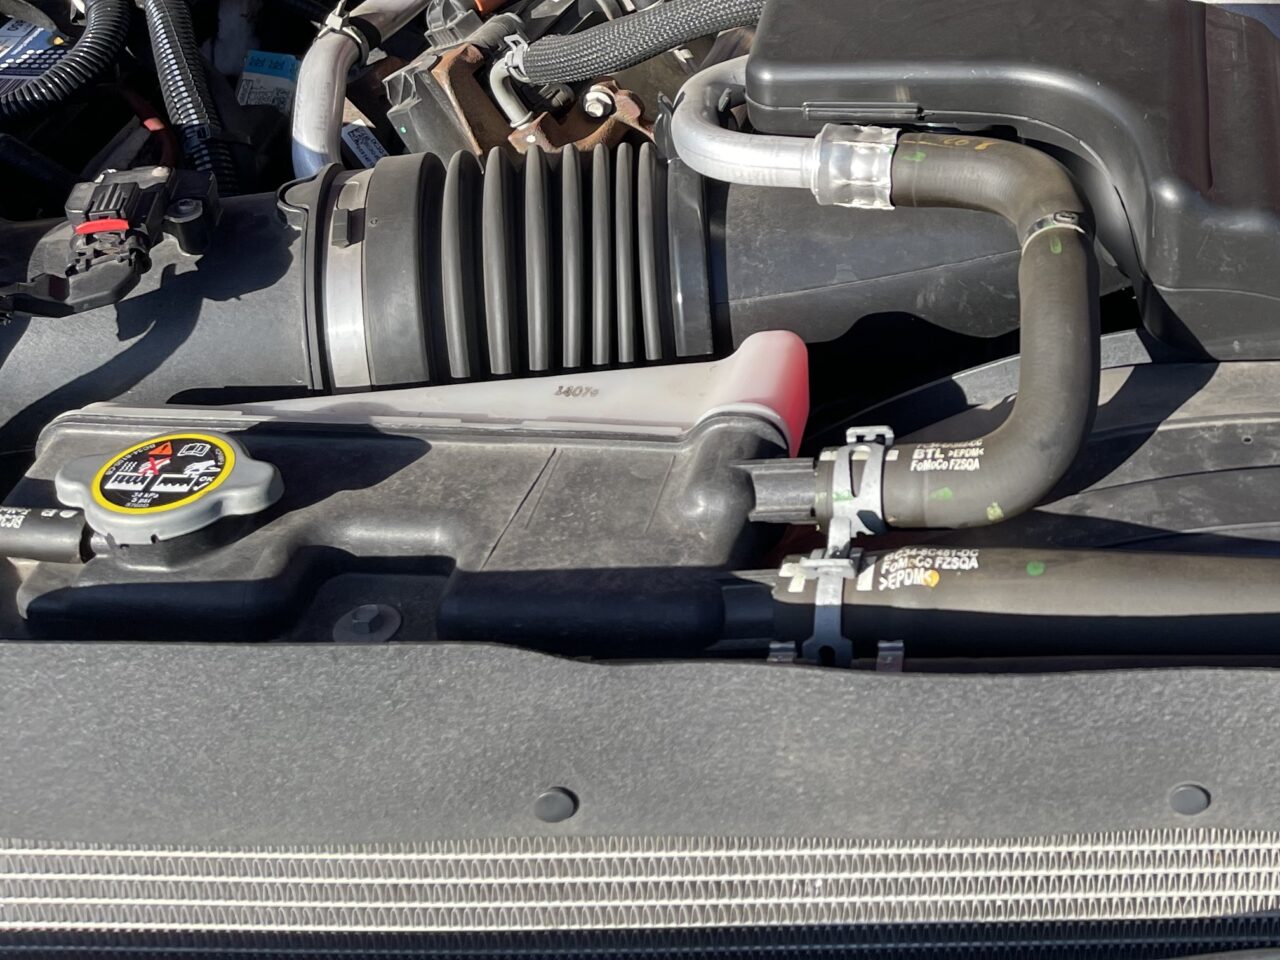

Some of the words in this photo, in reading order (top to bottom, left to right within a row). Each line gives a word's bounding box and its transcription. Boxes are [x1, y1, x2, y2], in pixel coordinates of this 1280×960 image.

[912, 448, 945, 460] BTL
[910, 458, 949, 471] FoMoCo
[949, 458, 980, 471] FZSQA
[934, 556, 979, 570] FZSQA
